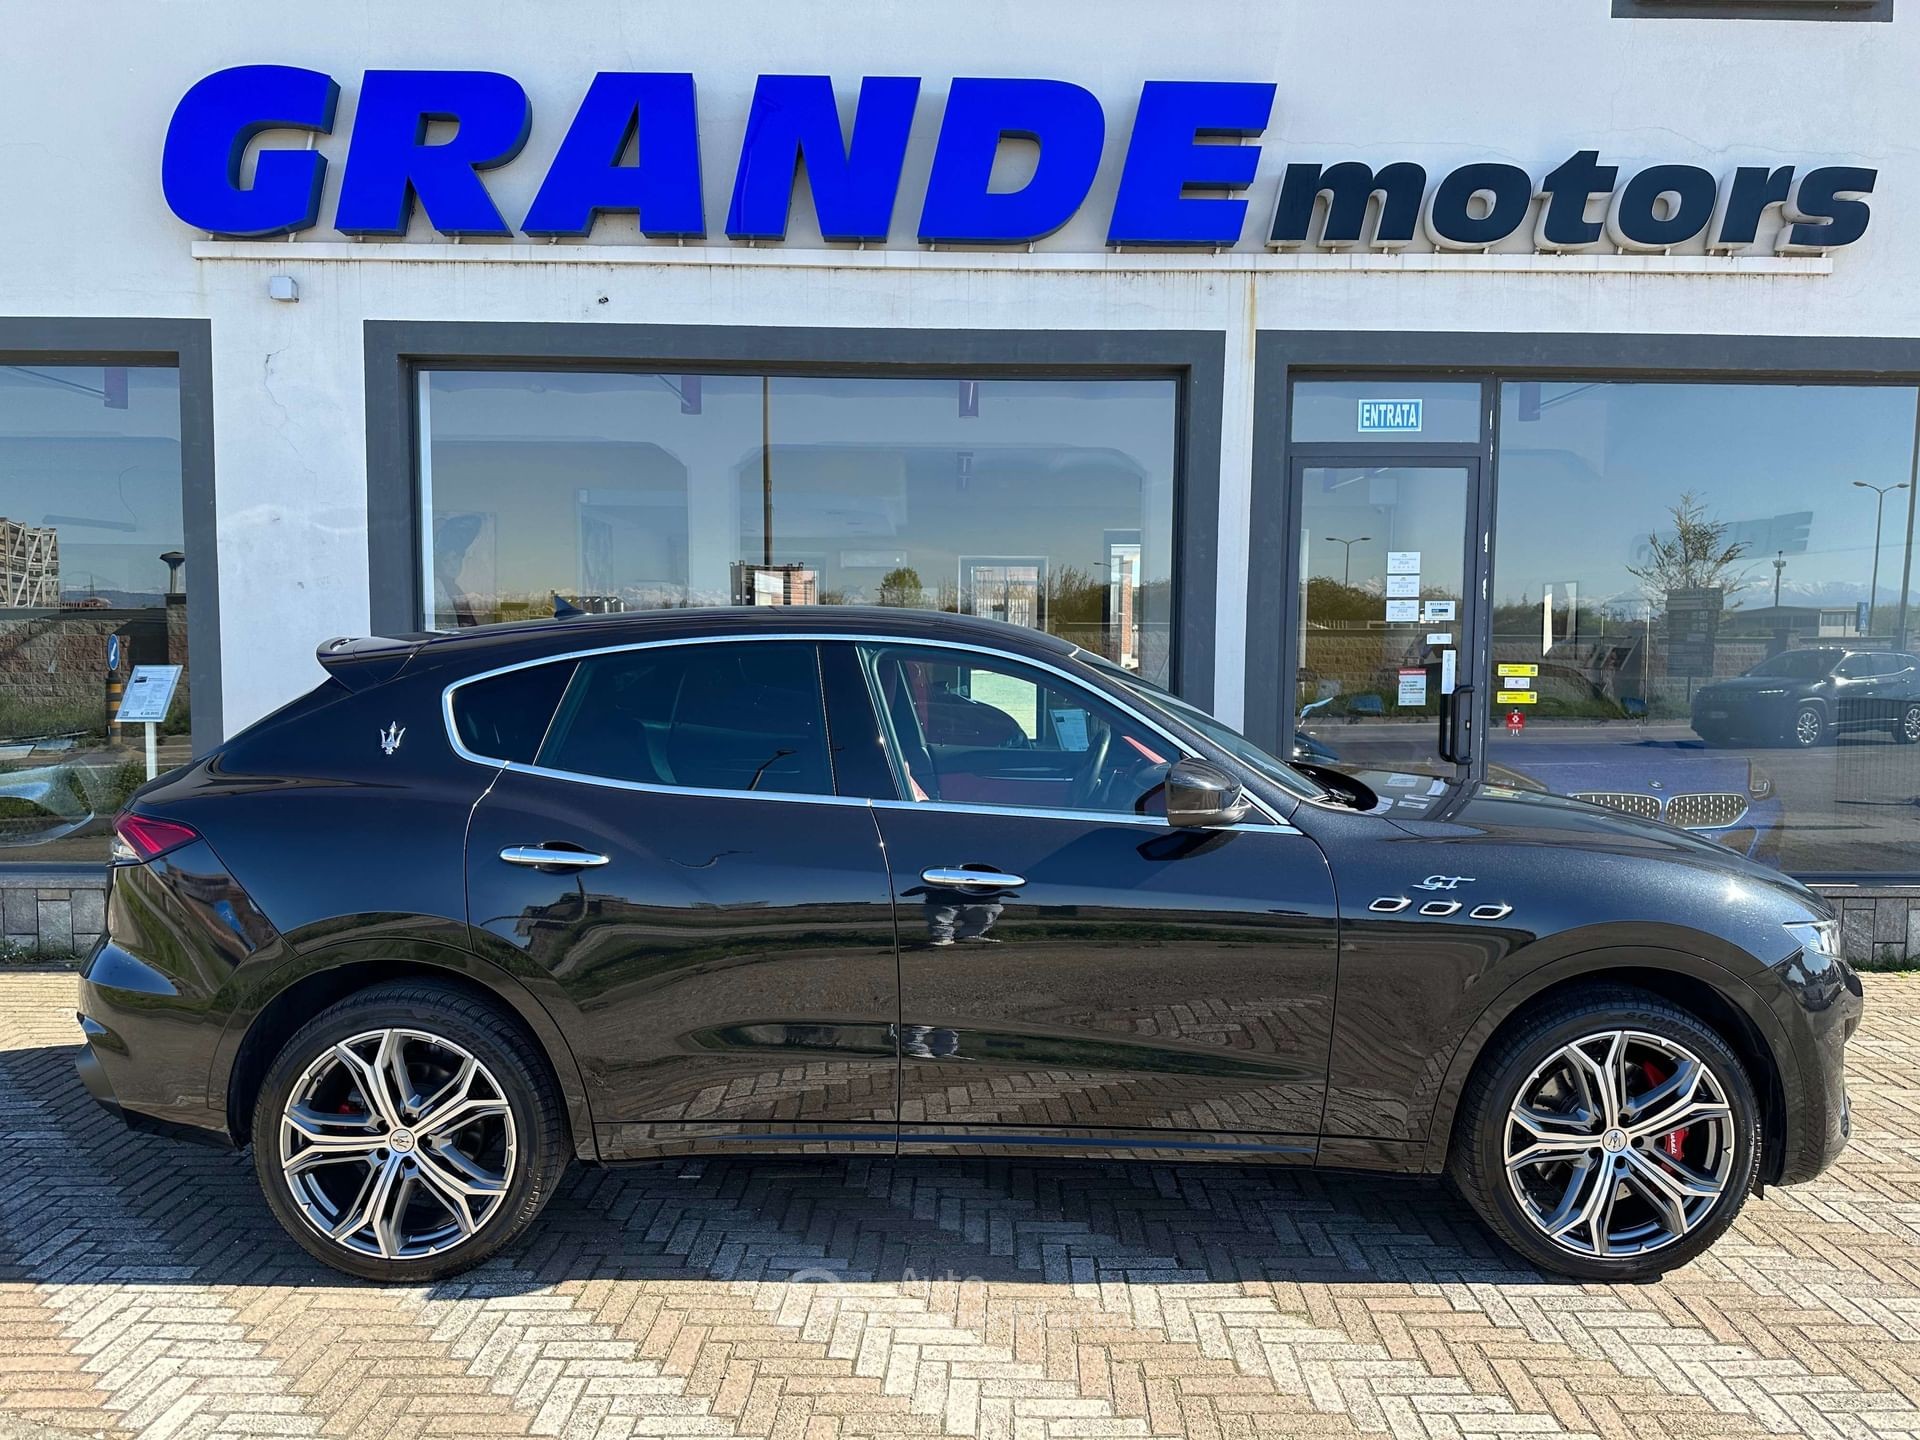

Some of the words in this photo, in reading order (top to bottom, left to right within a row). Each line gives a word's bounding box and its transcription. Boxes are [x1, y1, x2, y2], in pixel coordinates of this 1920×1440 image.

[161, 65, 1277, 248] GRANDE
[1266, 150, 1877, 252] motors
[1363, 403, 1418, 427] ENTRATA
